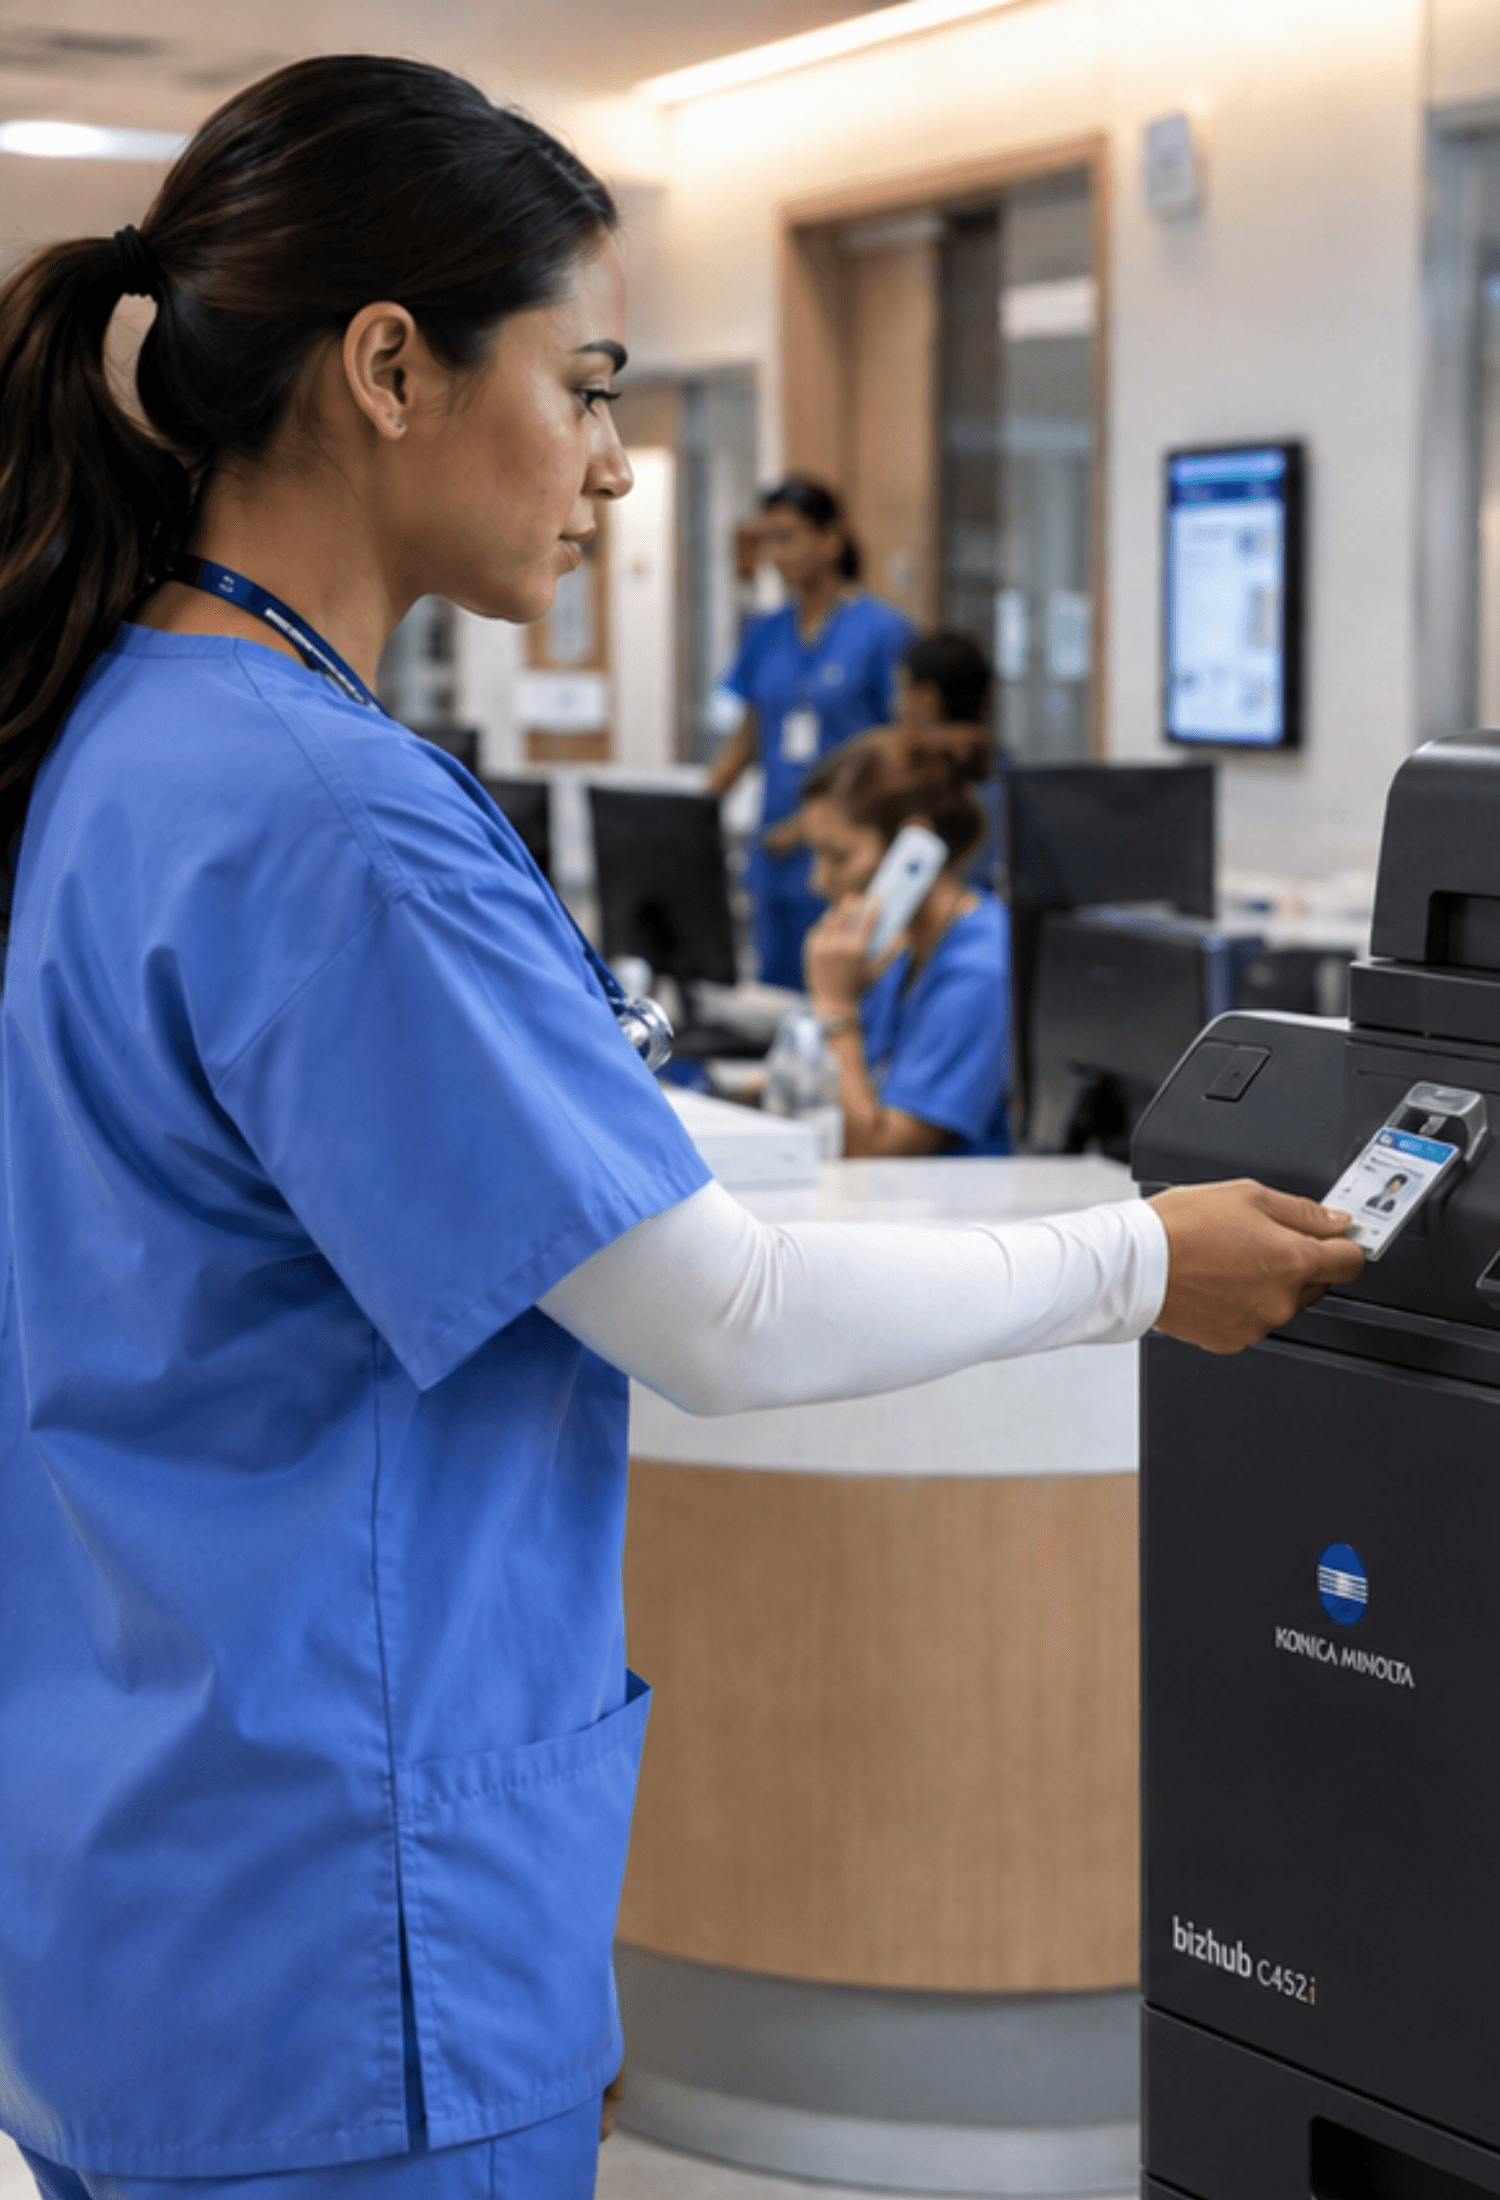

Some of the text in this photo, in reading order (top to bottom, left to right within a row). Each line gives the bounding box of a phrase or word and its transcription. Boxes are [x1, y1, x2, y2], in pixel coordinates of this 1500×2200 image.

[1275, 1626, 1415, 1688] KONICA MINOLTA
[1173, 1915, 1252, 1979] bizhub
